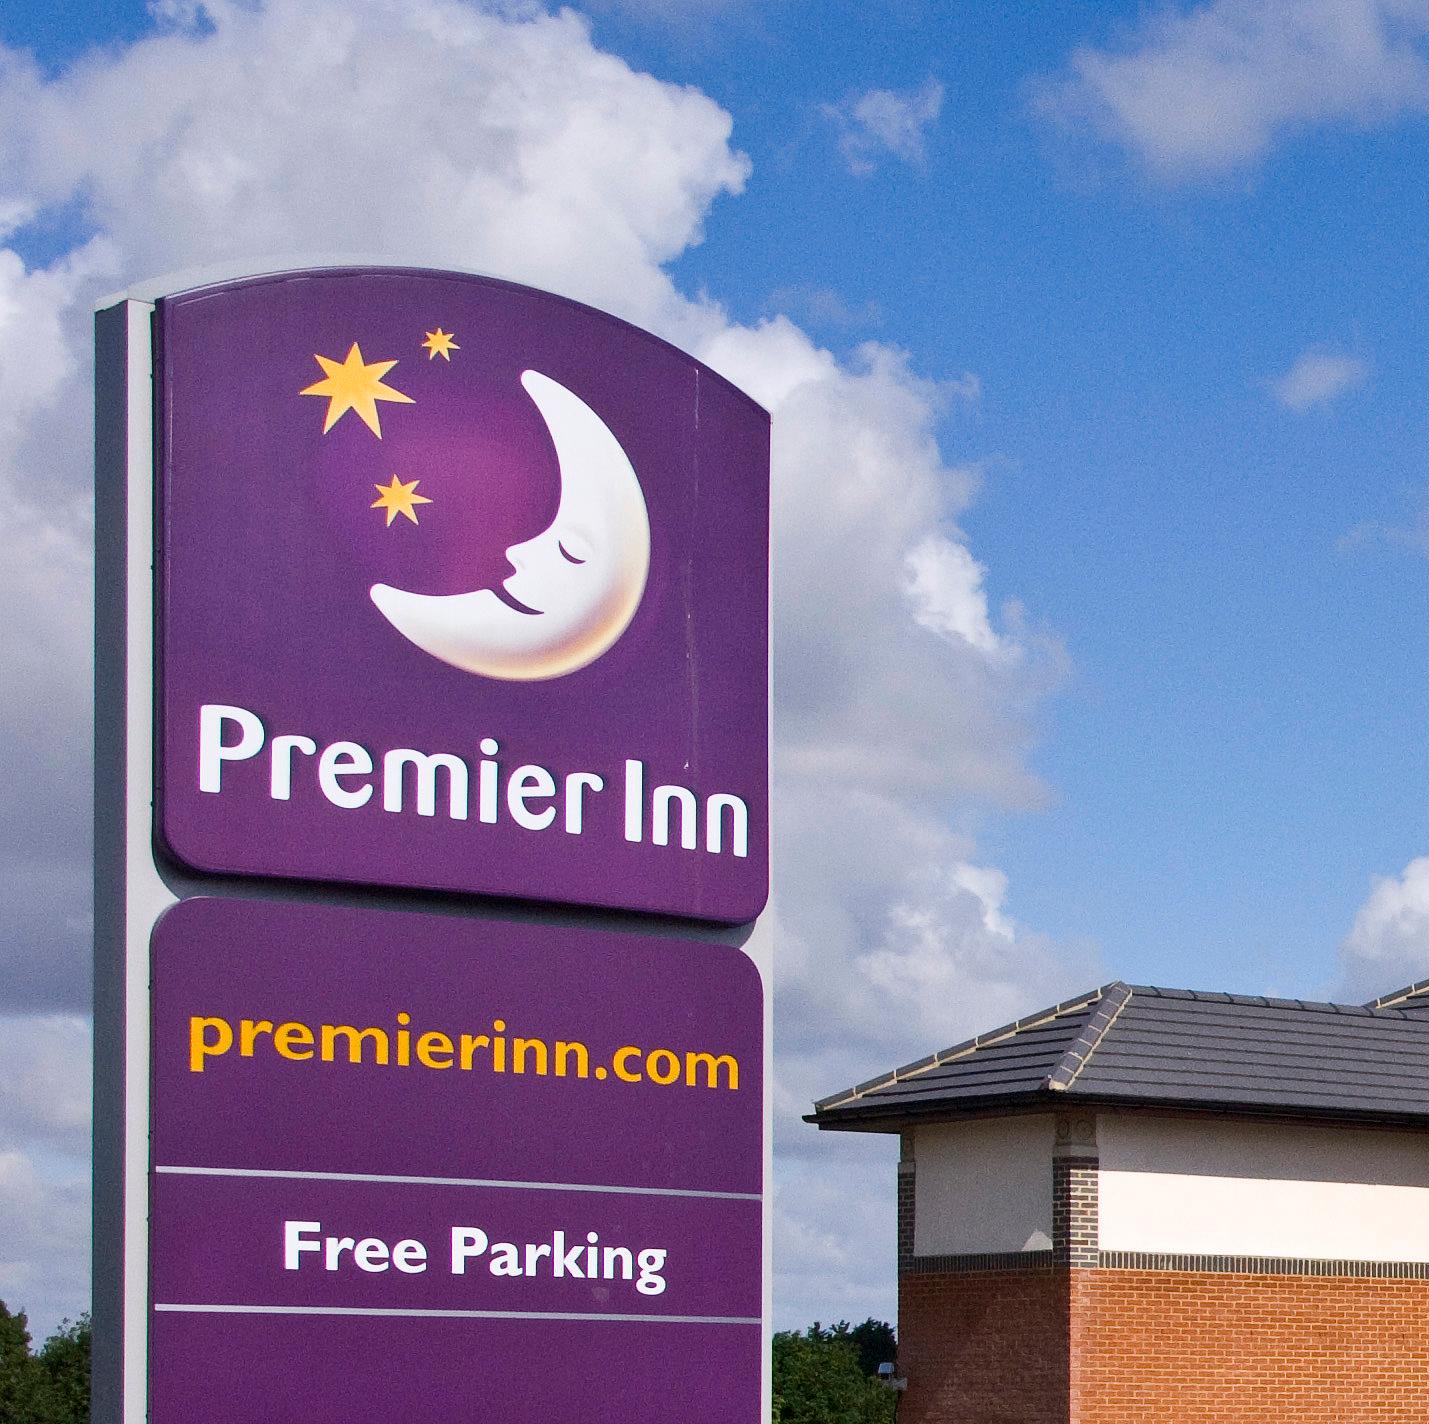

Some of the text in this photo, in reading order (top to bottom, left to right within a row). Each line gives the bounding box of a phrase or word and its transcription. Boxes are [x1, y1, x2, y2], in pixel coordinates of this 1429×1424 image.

[199, 704, 748, 858] Premier Inn
[189, 1012, 739, 1090] premierinn.com
[284, 1220, 667, 1296] Free Parking
